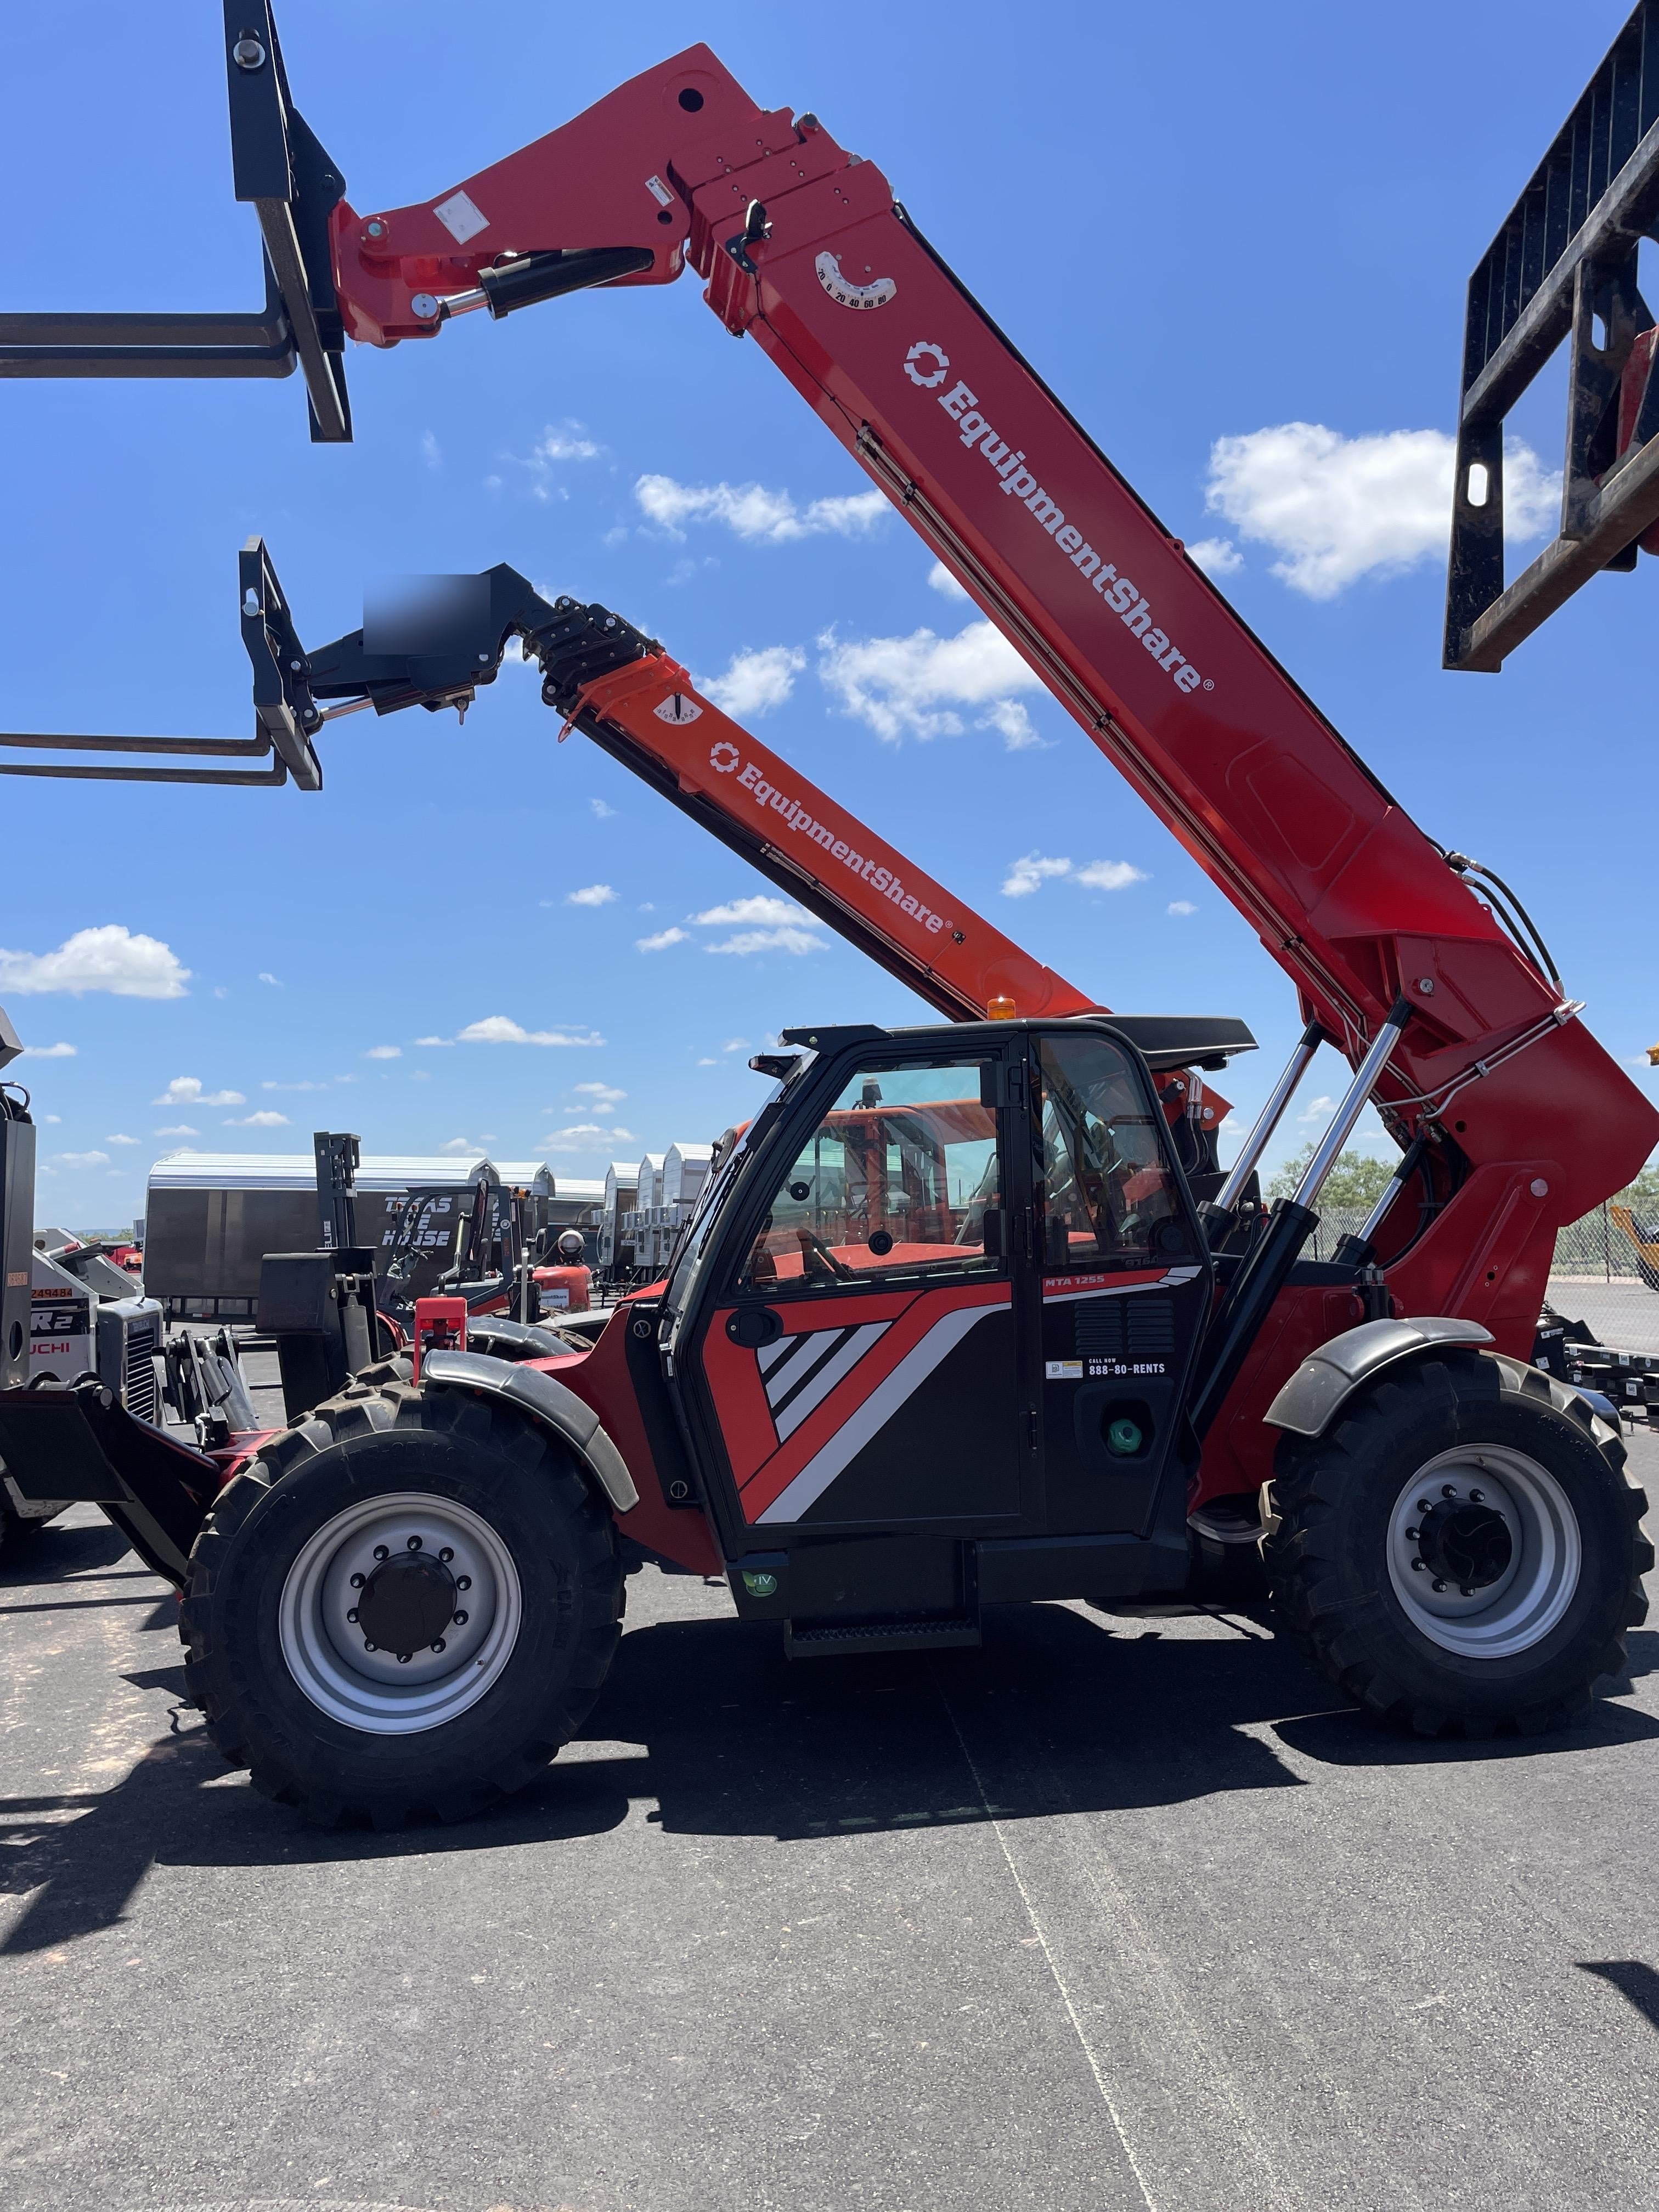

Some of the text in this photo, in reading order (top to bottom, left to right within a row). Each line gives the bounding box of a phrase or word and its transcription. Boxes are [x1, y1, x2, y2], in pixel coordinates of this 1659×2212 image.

[835, 292, 846, 303] 20
[849, 299, 859, 308] 40
[878, 295, 887, 305] 80
[1045, 1276, 1104, 1286] MTA 1255
[1089, 1363, 1165, 1375] 888-80-RENTS
[759, 1576, 772, 1584] IV
